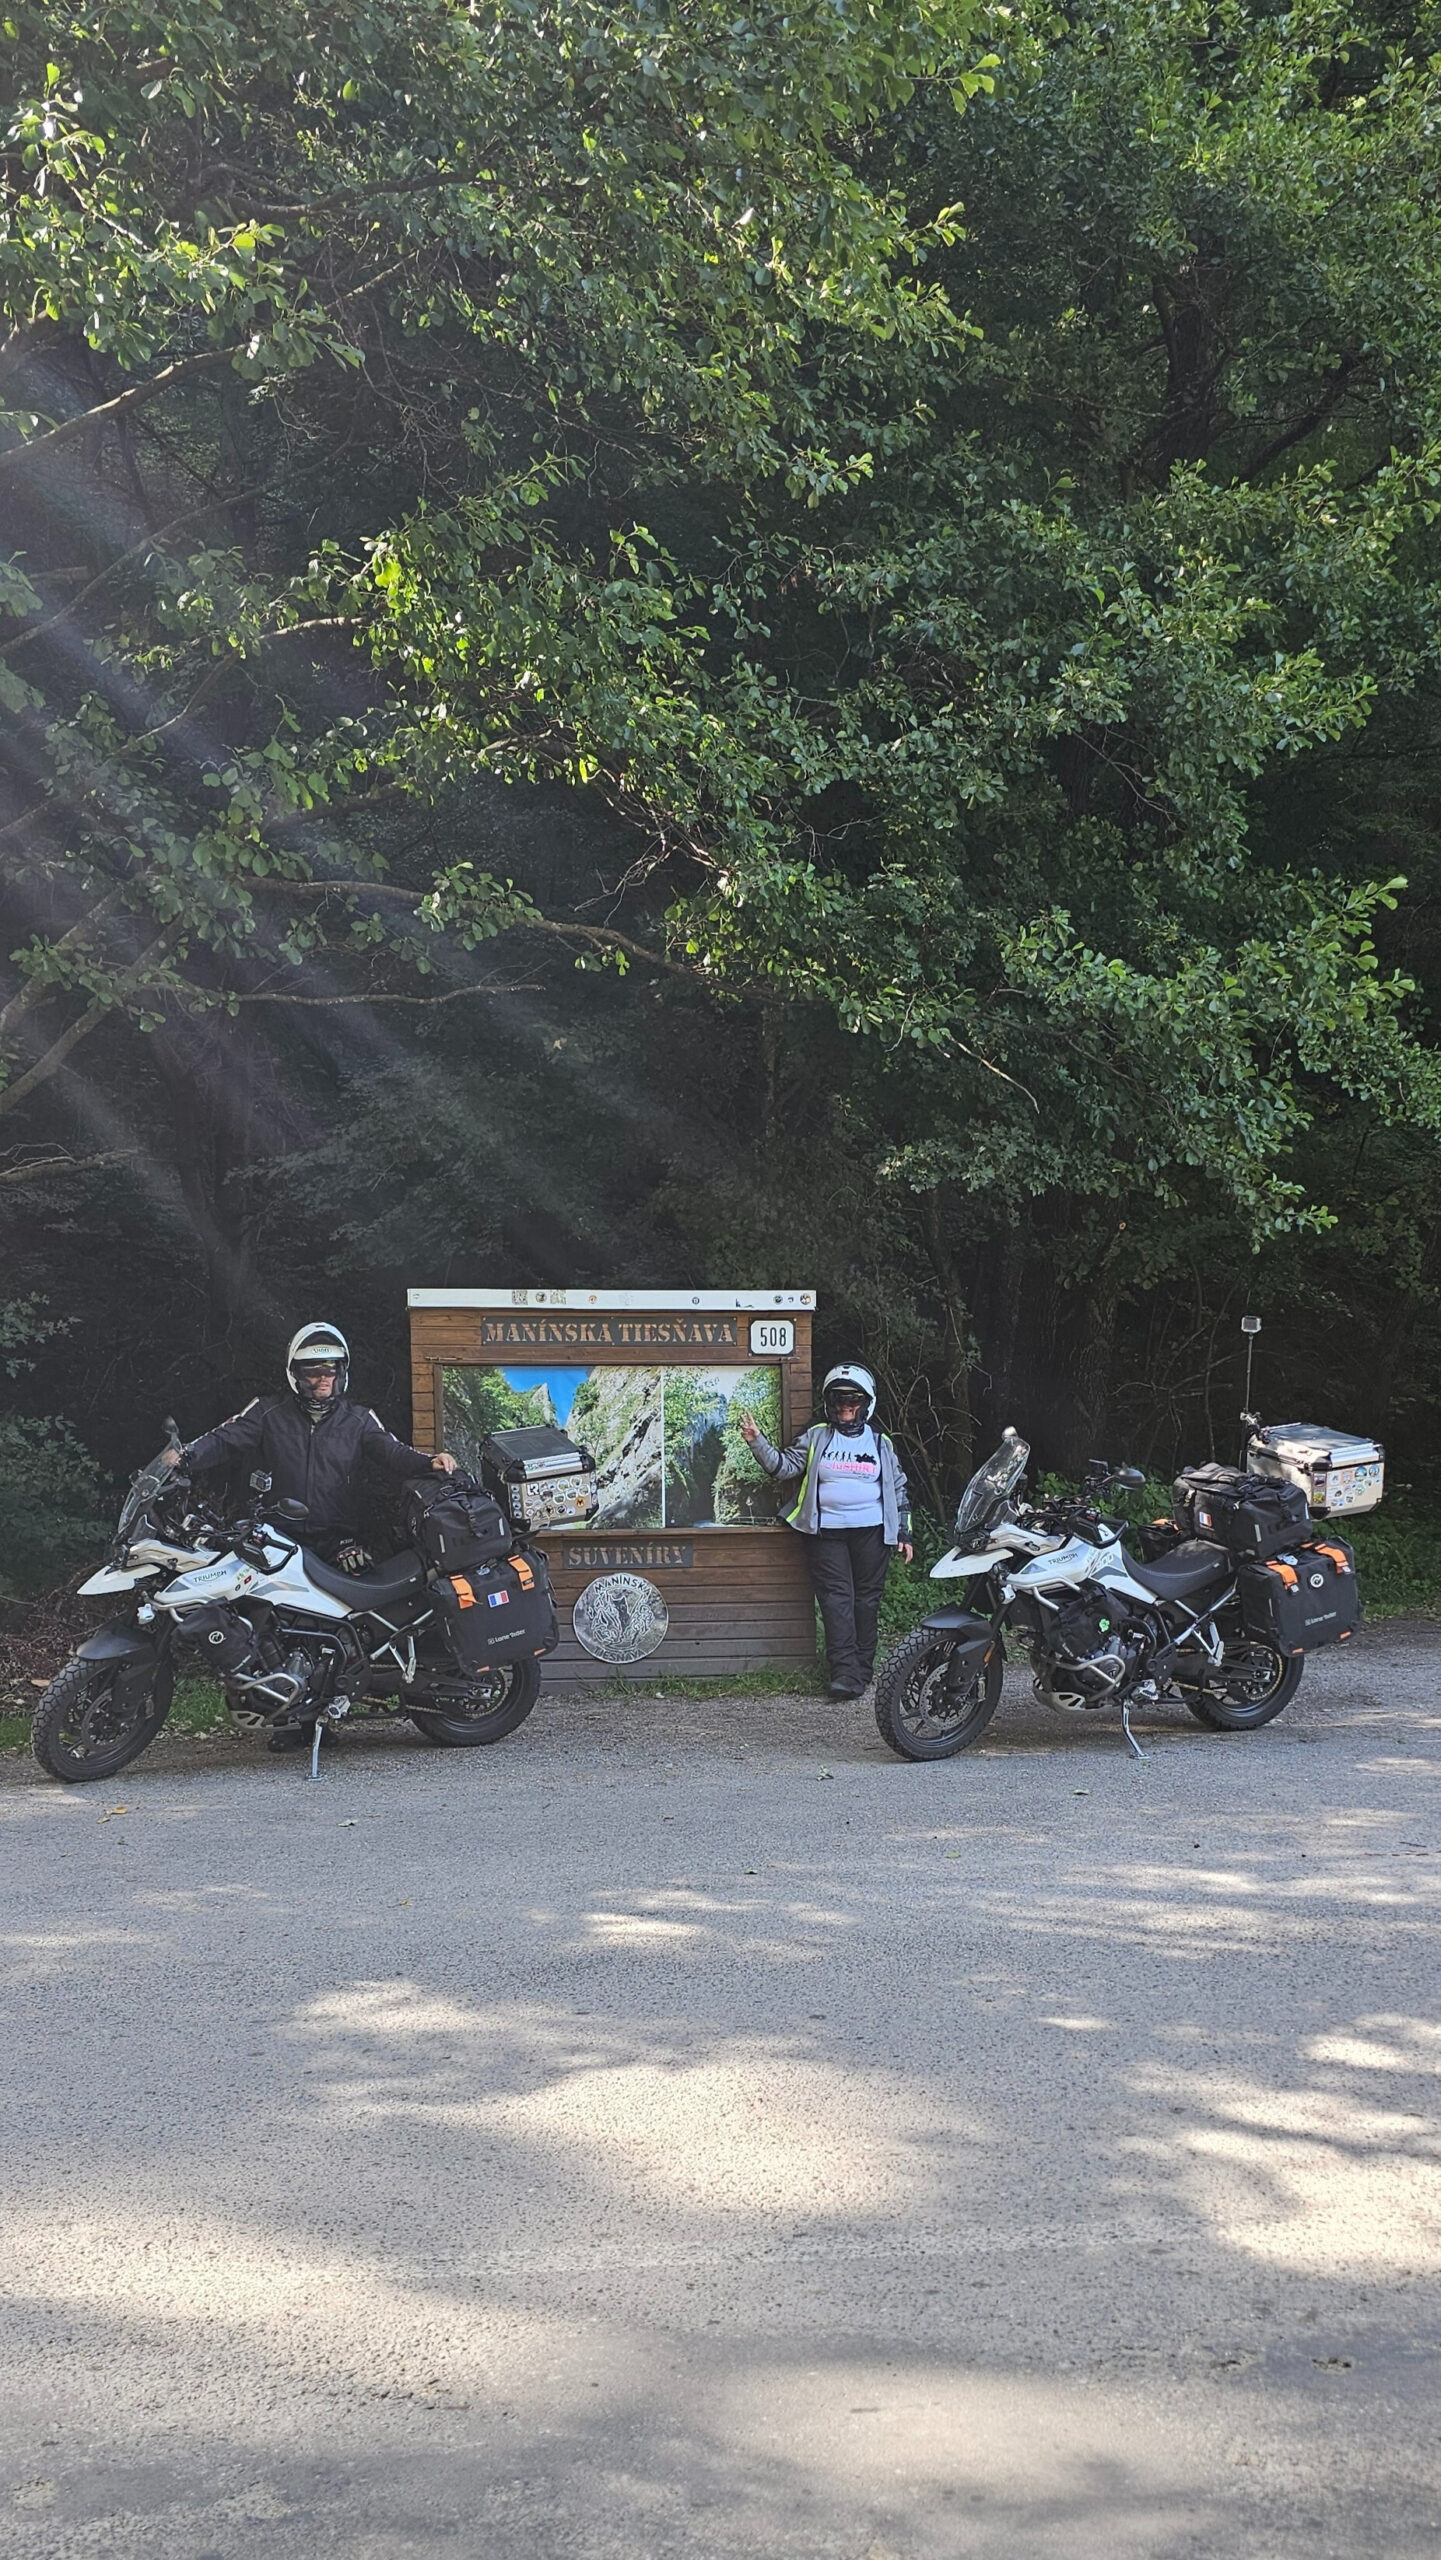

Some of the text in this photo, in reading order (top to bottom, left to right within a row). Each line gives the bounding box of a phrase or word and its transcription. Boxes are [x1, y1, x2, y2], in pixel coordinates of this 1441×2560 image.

[485, 1318, 734, 1342] MANÍNSKA TIESŇAVA
[760, 1327, 787, 1347] 508
[568, 1542, 686, 1566] SUVENÍRY
[1048, 1552, 1078, 1565] TRIUMPH
[194, 1570, 227, 1583] TRIUMPH
